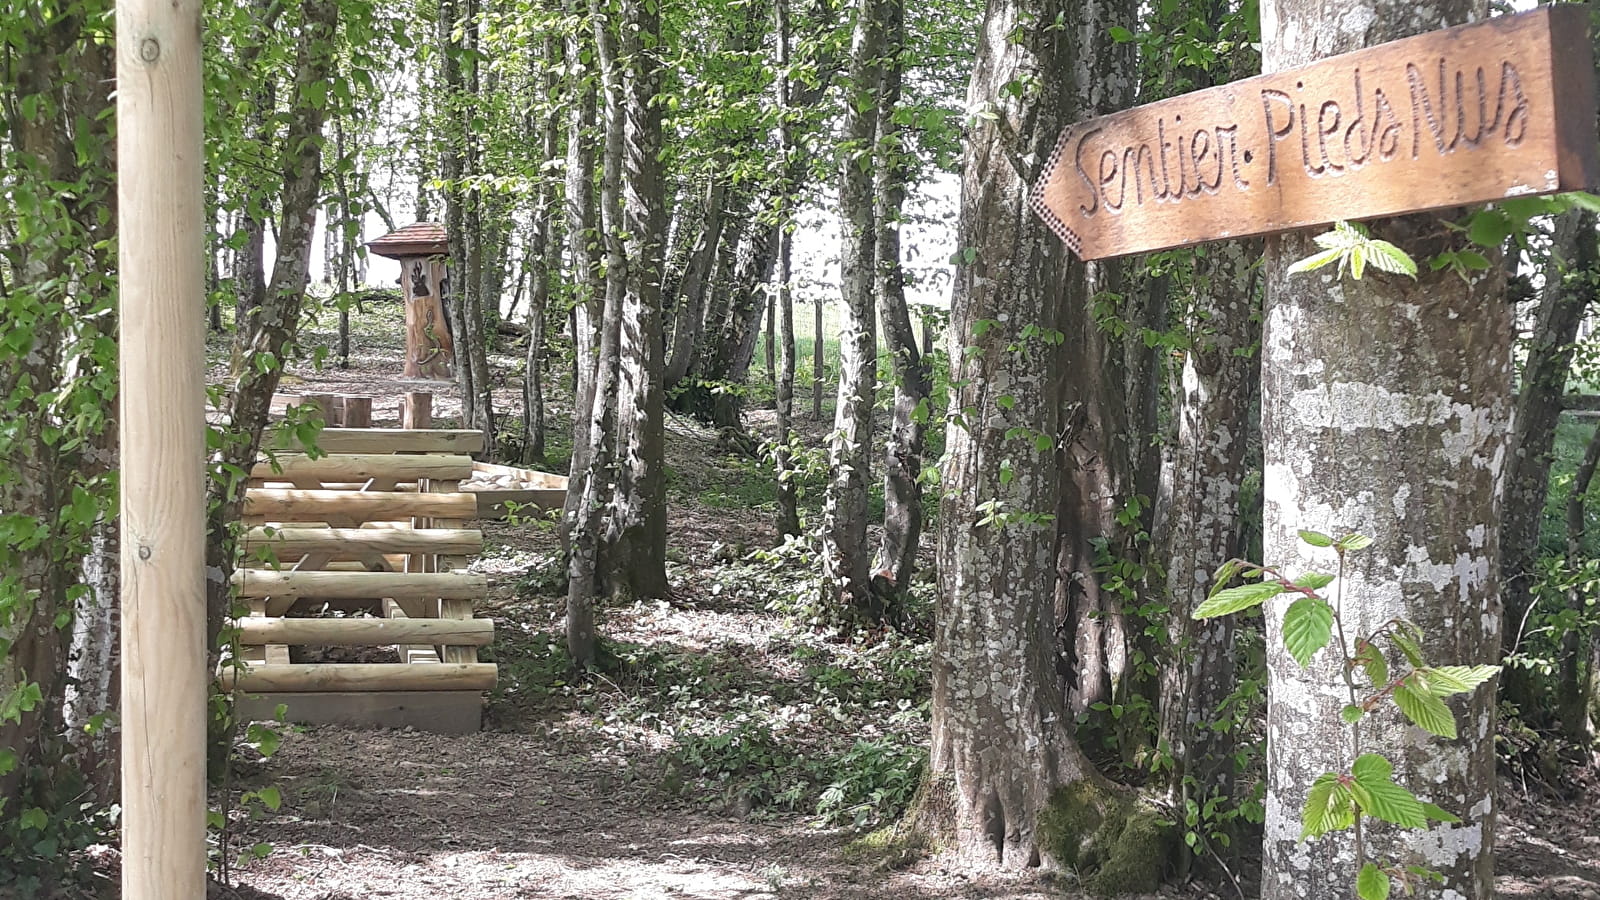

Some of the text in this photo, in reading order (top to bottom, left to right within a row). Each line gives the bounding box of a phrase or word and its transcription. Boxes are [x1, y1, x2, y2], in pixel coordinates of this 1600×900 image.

[1075, 57, 1529, 219] Sentier Pieds Nus
